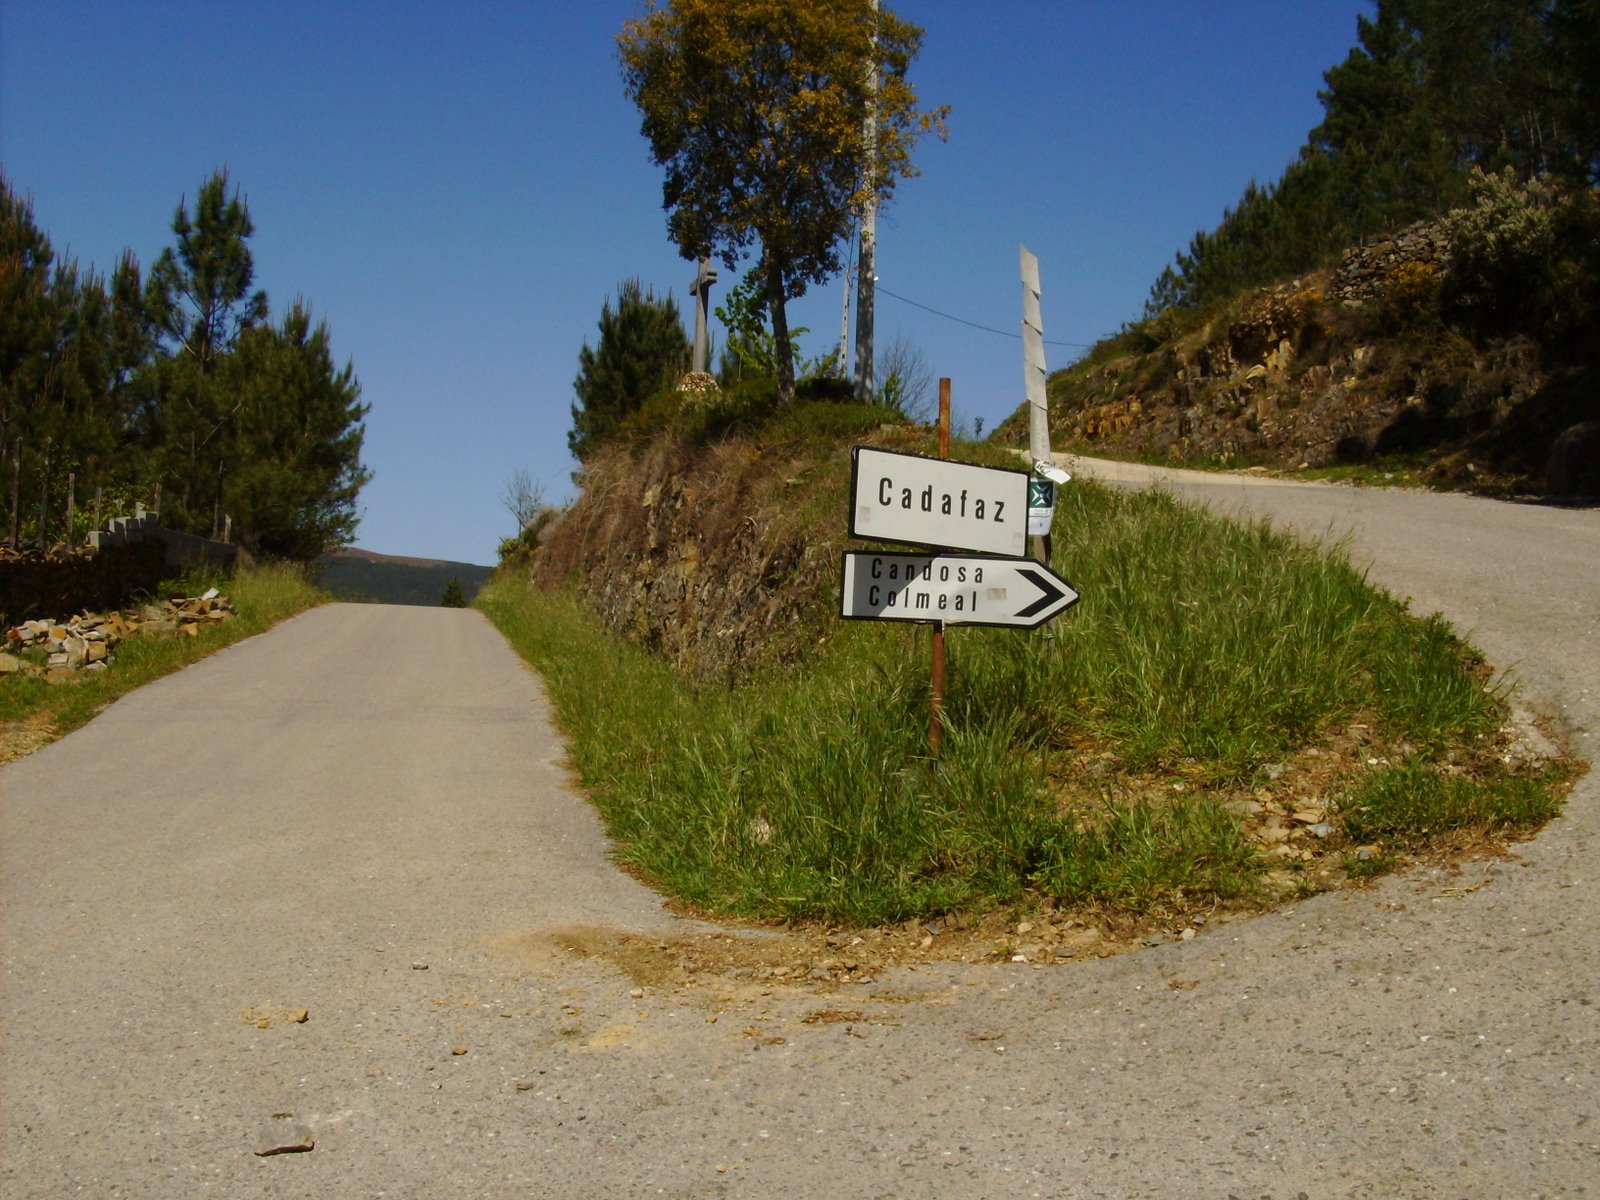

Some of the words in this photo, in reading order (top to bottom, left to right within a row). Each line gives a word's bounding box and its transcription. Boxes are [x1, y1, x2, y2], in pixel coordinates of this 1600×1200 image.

[878, 477, 1005, 523] Cadafaz
[871, 557, 983, 583] Candosa
[869, 585, 977, 612] Colmeal
